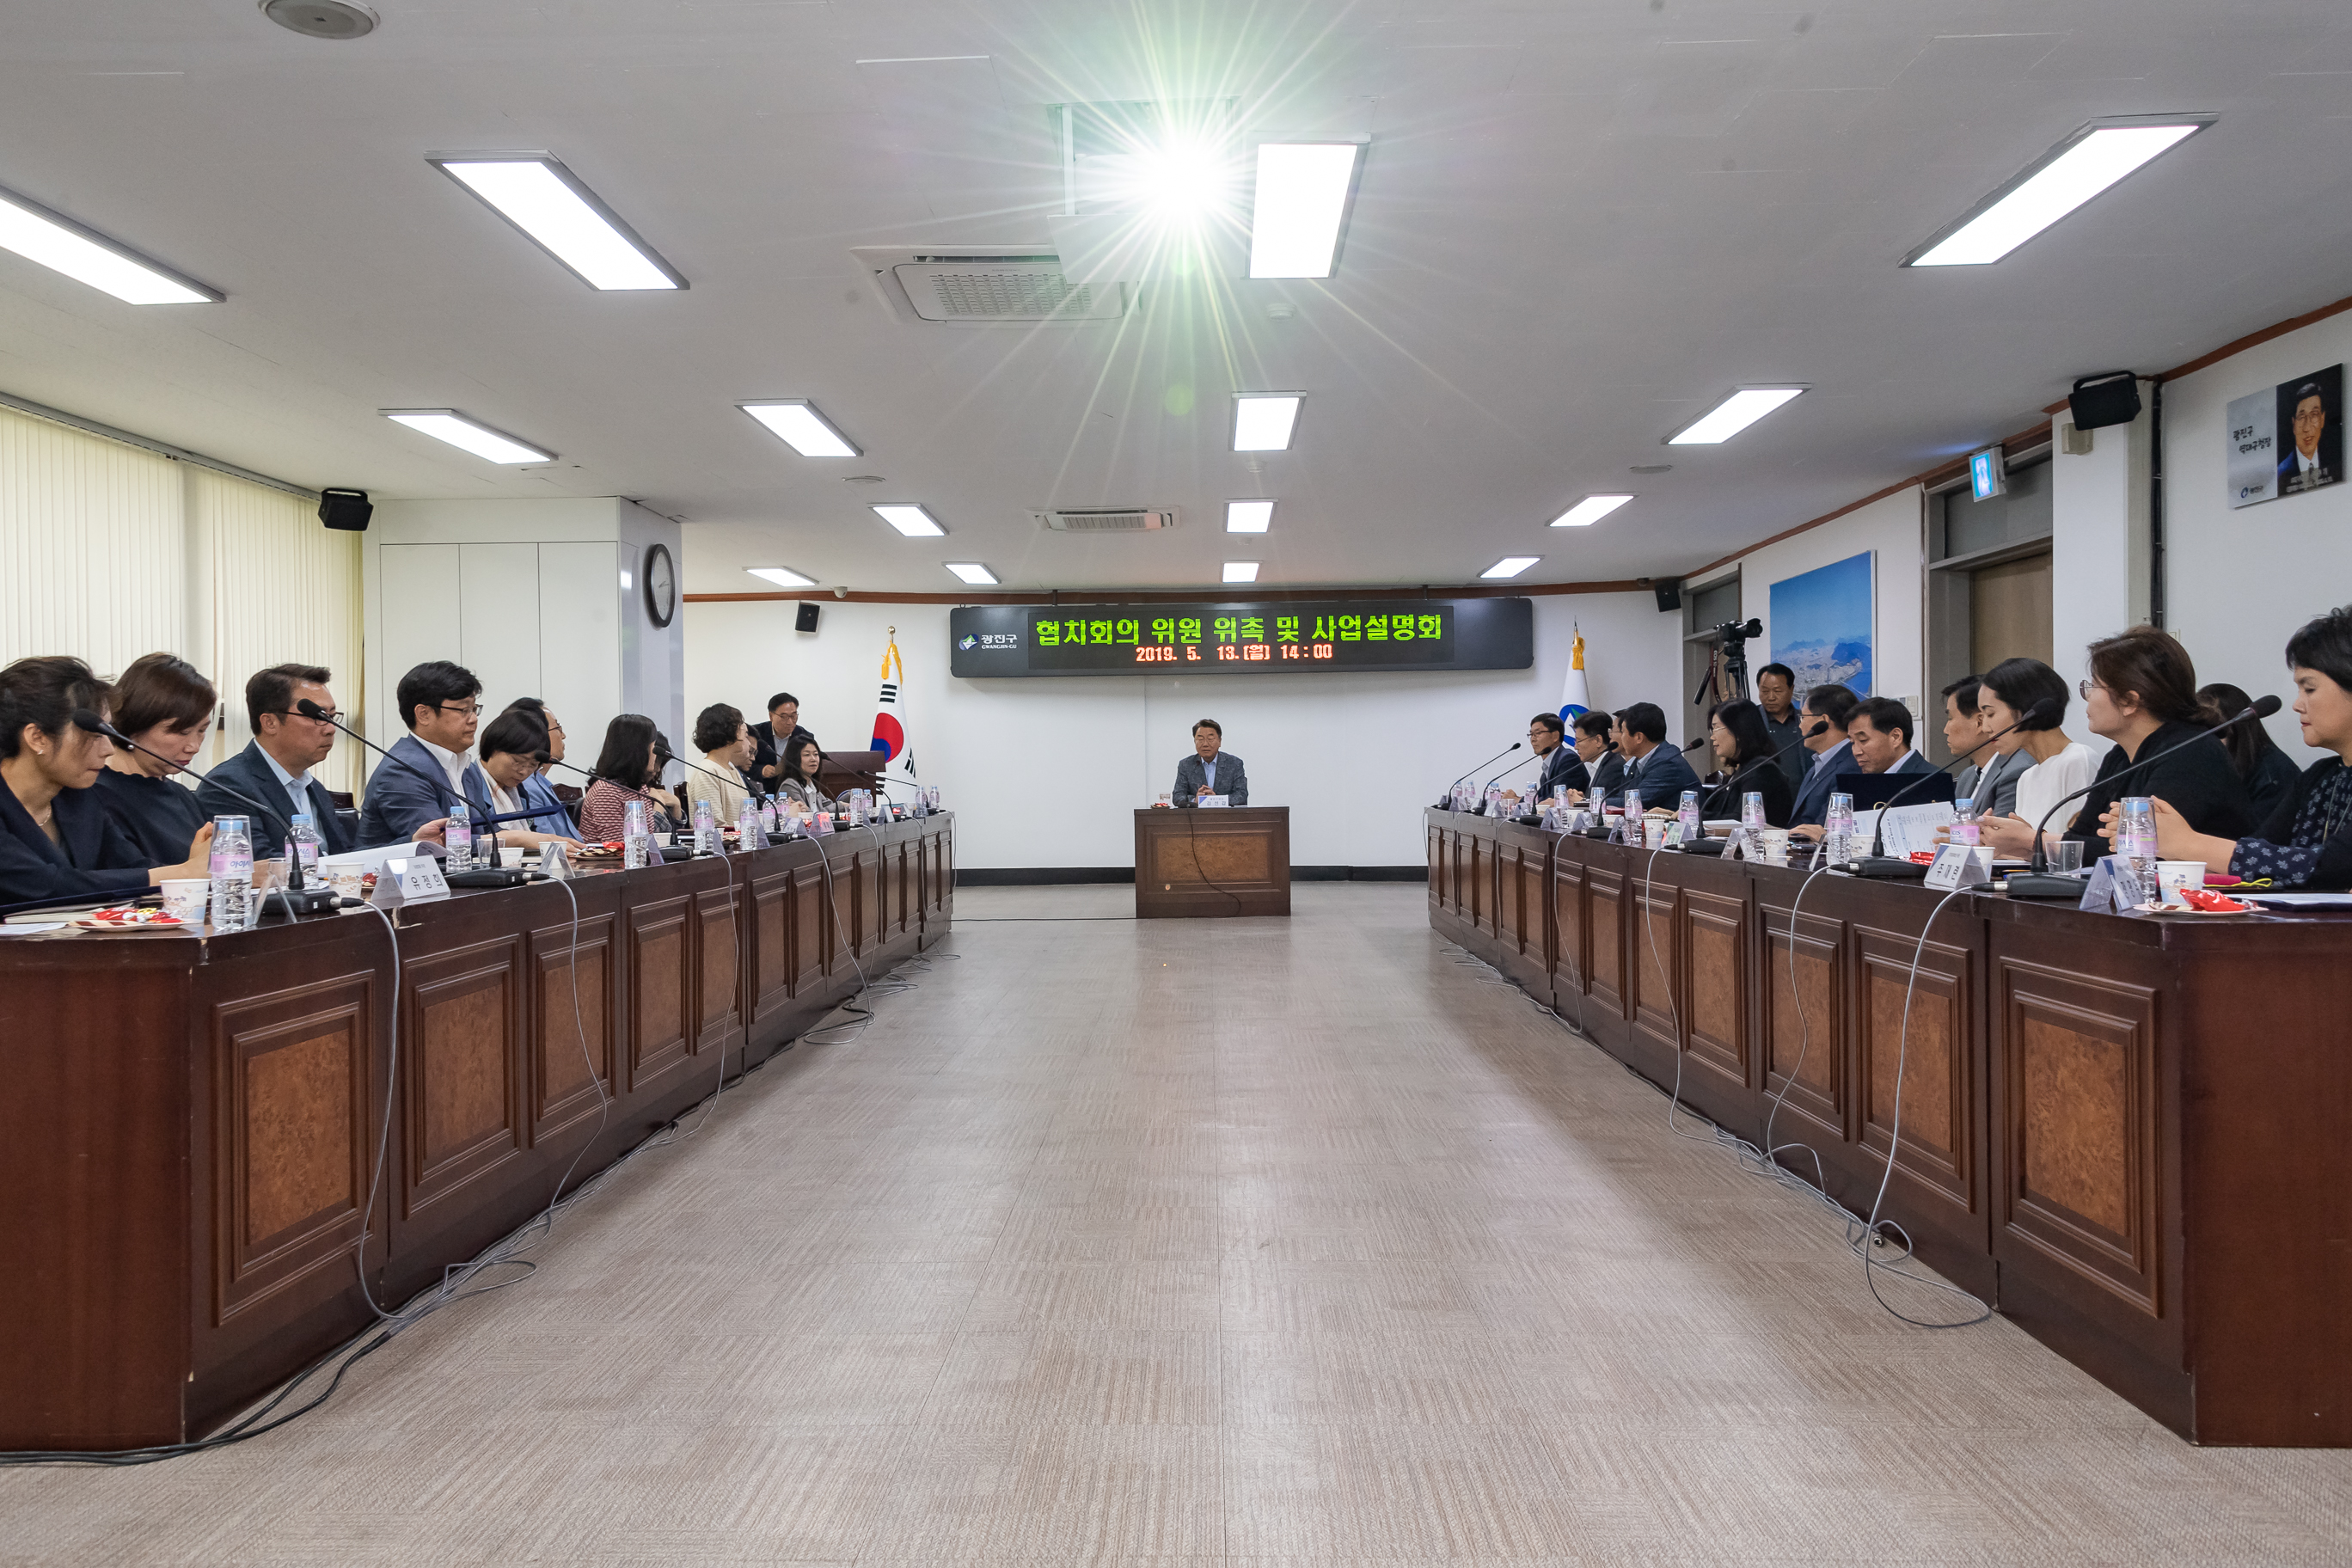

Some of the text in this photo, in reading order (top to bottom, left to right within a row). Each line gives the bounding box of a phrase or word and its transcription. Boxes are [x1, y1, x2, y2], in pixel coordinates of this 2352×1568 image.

[1036, 614, 1442, 646] 협치회의 위원 위촉 및 사업설명회
[981, 634, 1018, 645] 광진구
[1136, 646, 1178, 662] 2019.
[1186, 646, 1202, 660] 5.
[410, 873, 443, 891] 유정희
